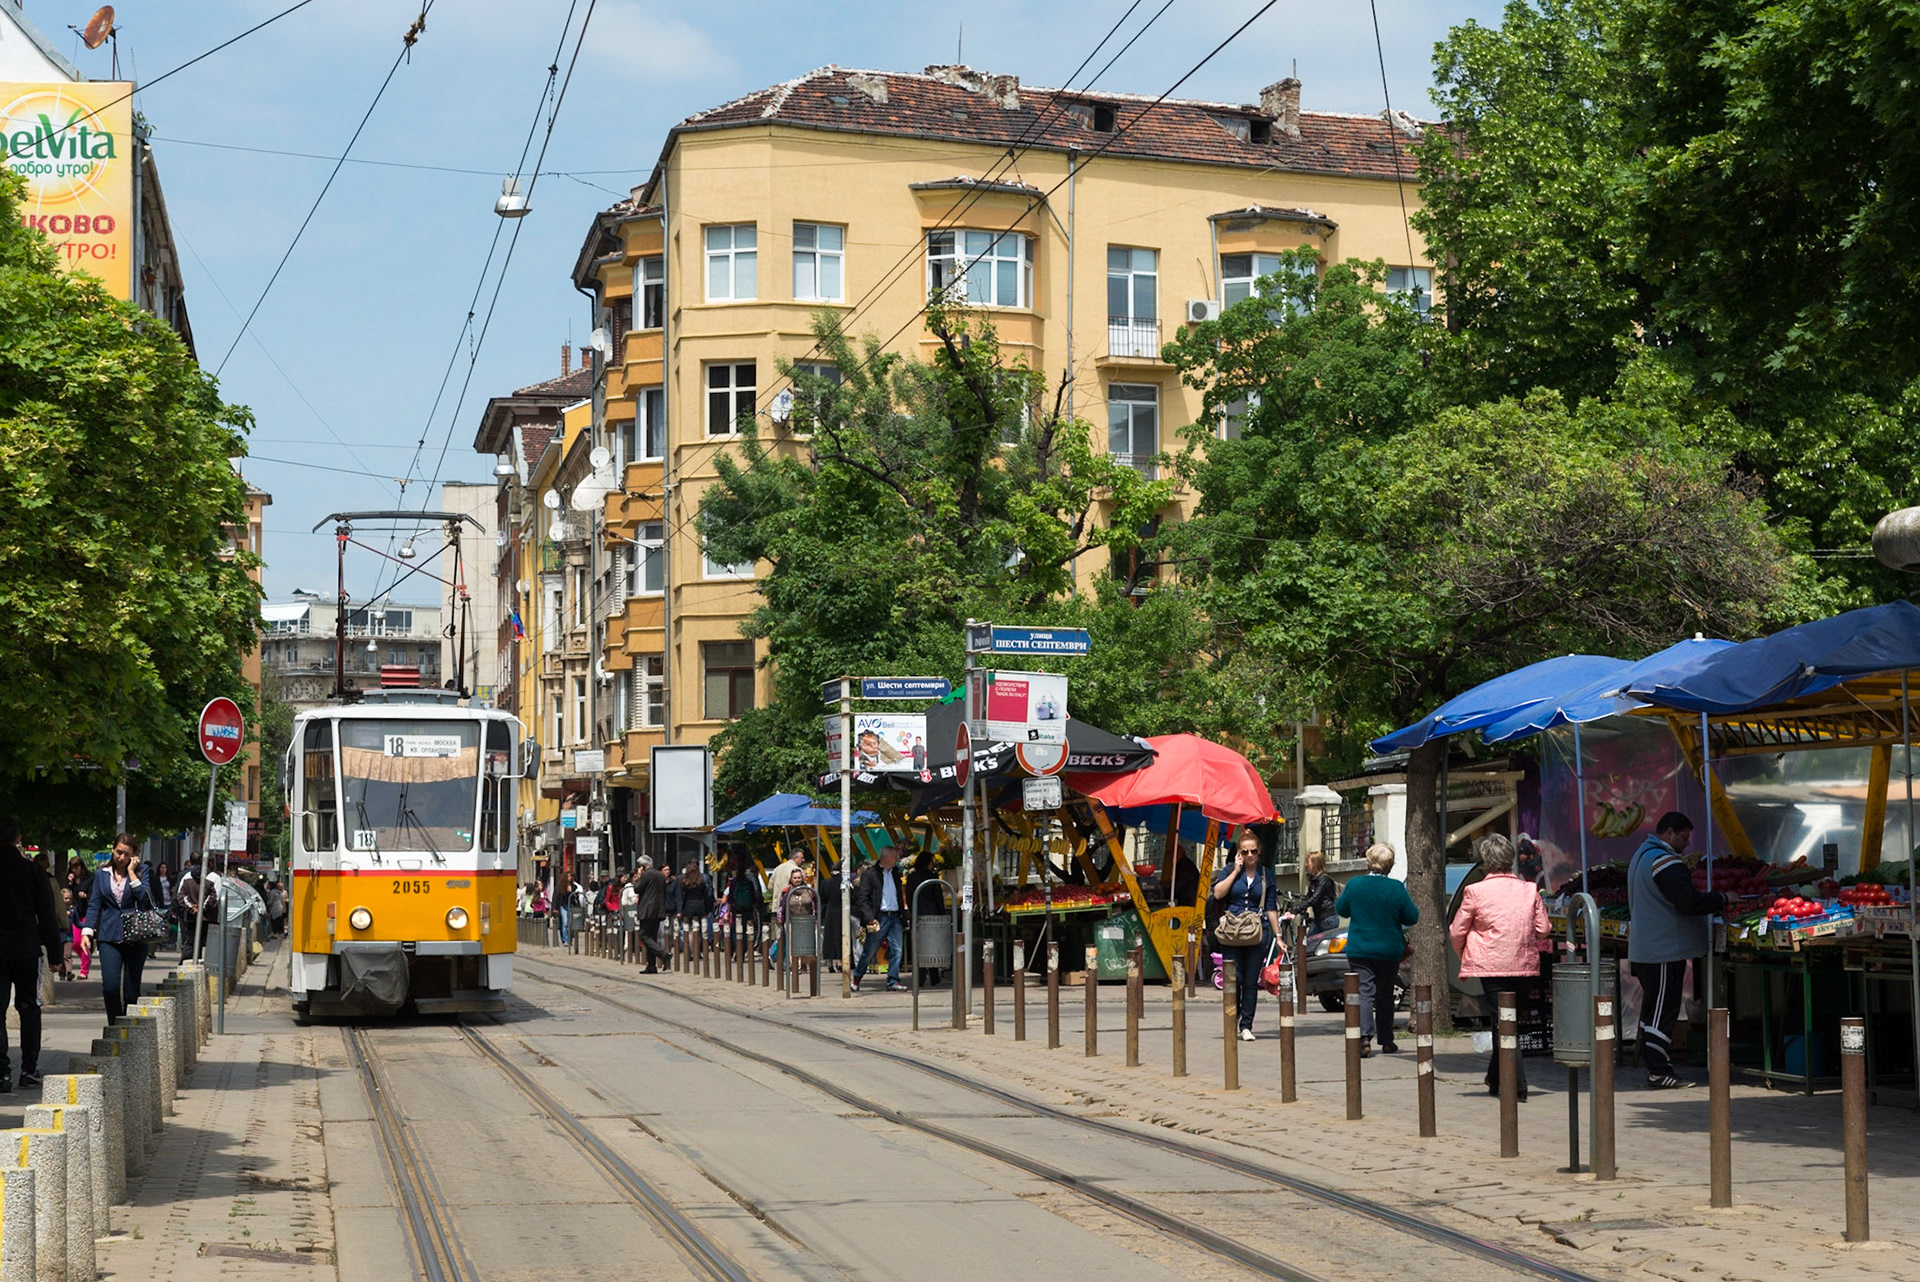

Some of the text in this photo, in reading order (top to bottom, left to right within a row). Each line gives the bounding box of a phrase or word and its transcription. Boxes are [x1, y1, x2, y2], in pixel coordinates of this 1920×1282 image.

[57, 160, 94, 178] утро!
[1030, 632, 1053, 640] улица
[995, 640, 1029, 649] ШЕСТИ
[1031, 641, 1087, 650] СЕПТЕМВРИ
[389, 737, 404, 754] 18
[939, 756, 999, 779] BK'S
[1068, 754, 1127, 767] BECK'S
[358, 833, 373, 847] 18
[393, 880, 430, 894] 2055
